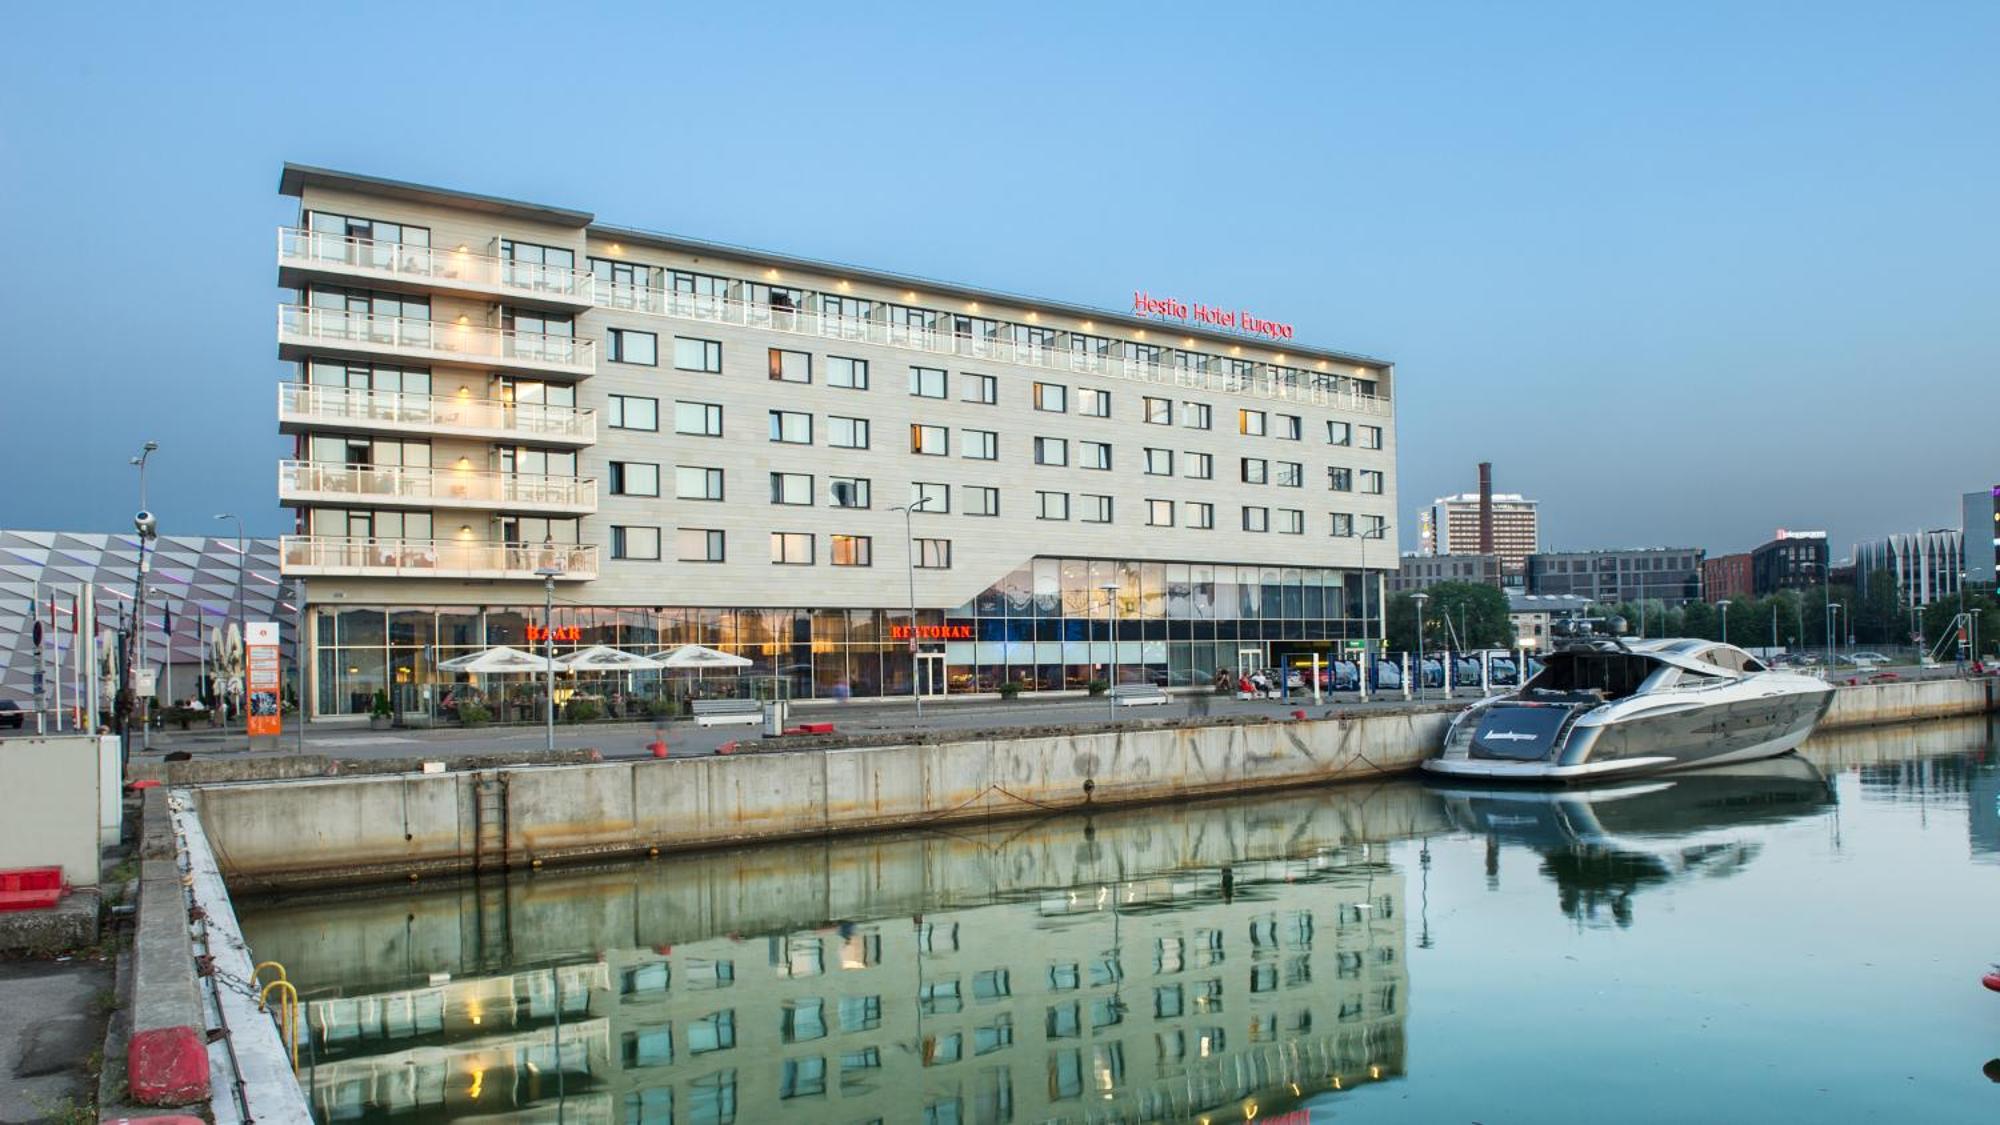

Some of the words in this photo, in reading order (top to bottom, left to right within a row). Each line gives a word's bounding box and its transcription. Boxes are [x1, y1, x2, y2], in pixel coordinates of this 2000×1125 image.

[1134, 290, 1187, 319] Hestia
[1193, 304, 1235, 327] Hotel
[1241, 312, 1292, 338] Europa
[526, 624, 582, 641] BAAR
